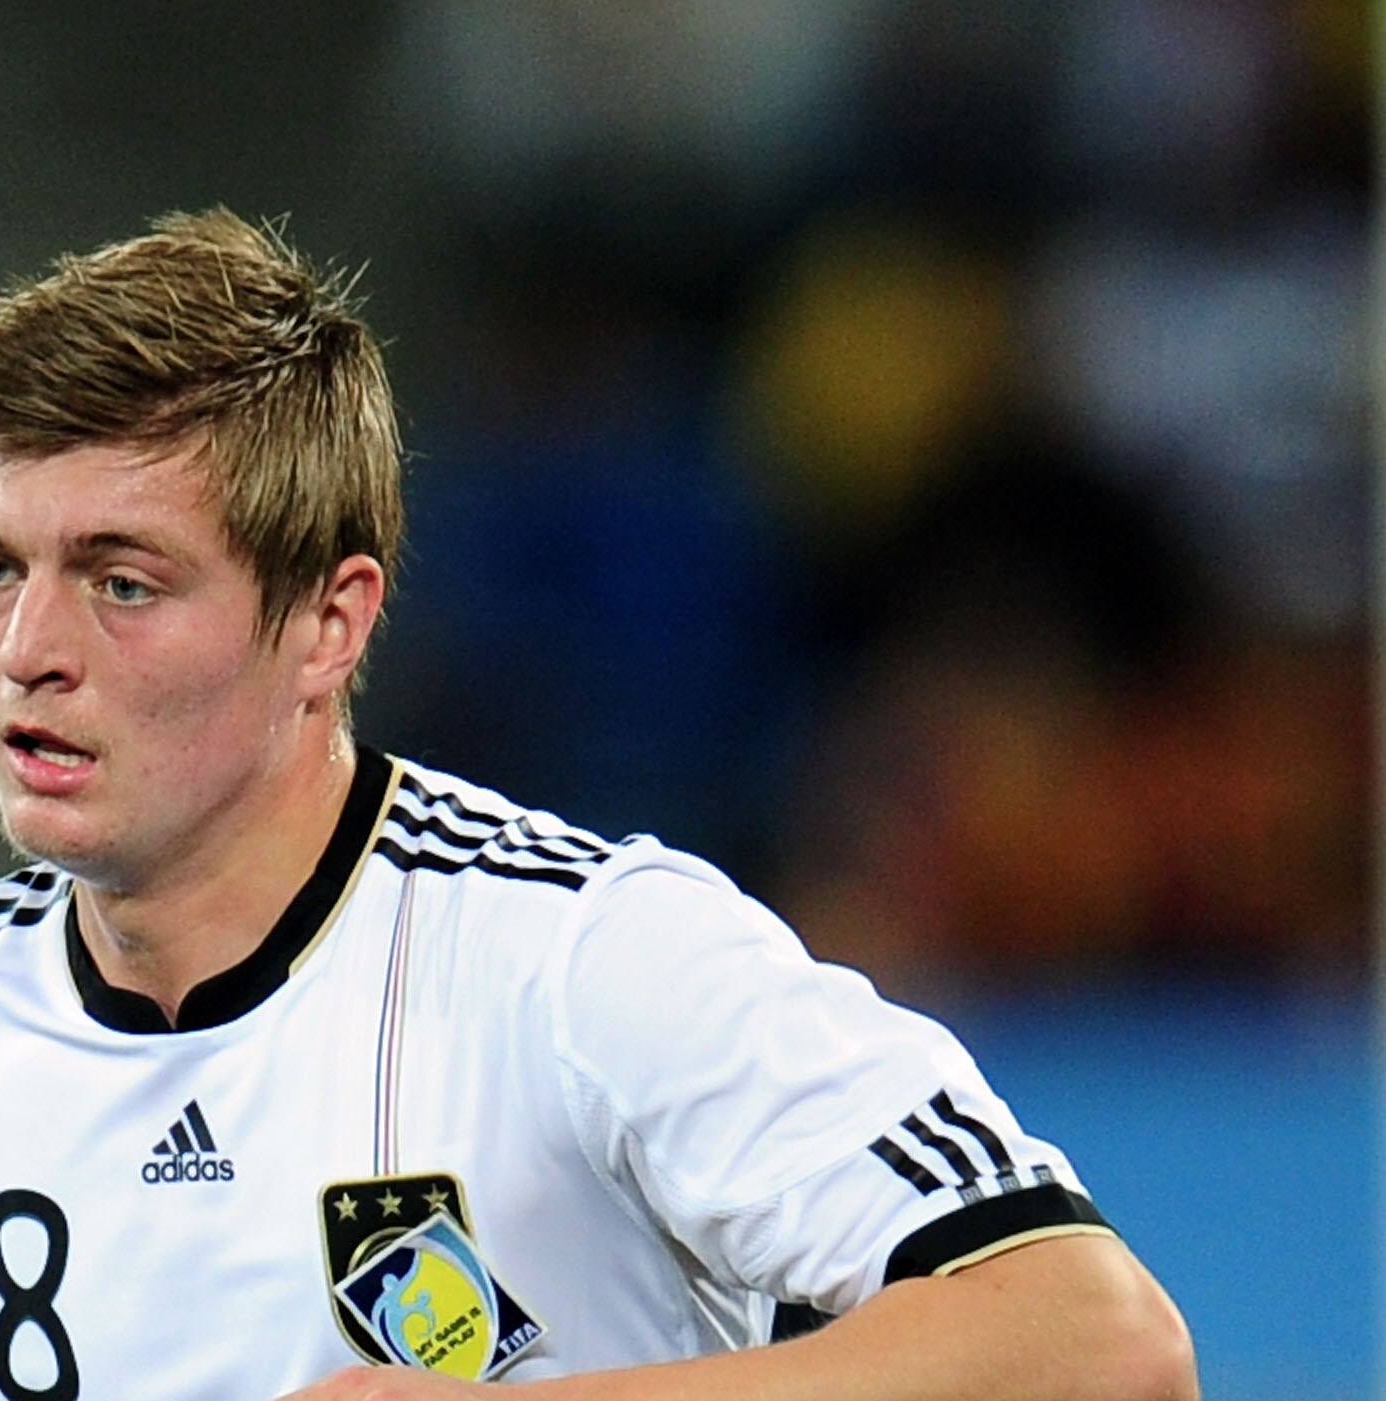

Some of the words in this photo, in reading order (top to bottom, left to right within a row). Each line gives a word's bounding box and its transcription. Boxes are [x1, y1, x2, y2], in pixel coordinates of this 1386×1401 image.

[141, 1152, 234, 1183] adidas
[415, 1340, 433, 1357] MY
[435, 1316, 469, 1342] GAME
[423, 1347, 448, 1368] FAIR
[449, 1327, 475, 1349] PLAY
